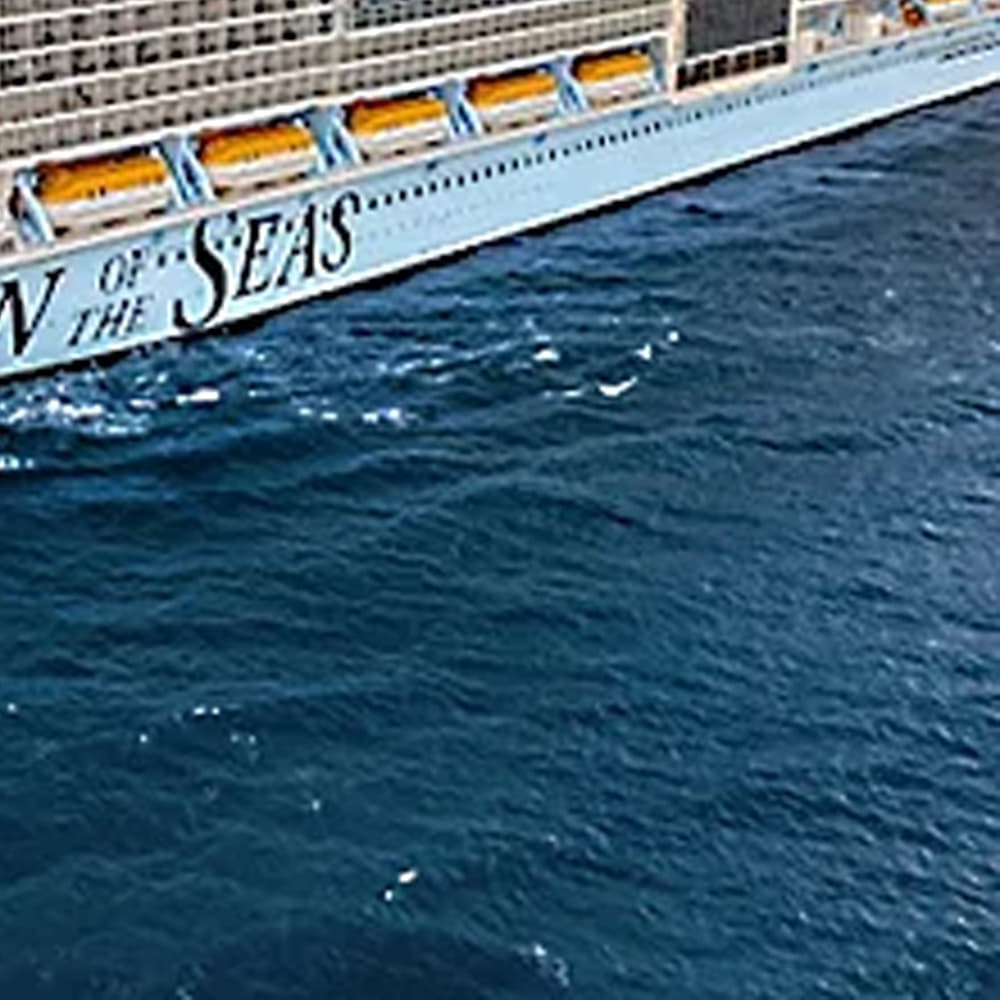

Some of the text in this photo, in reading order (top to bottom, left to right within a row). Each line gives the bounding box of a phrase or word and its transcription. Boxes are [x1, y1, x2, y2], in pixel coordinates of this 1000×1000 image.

[99, 249, 150, 294] OF
[173, 192, 360, 329] SEAS
[68, 296, 151, 348] THE
